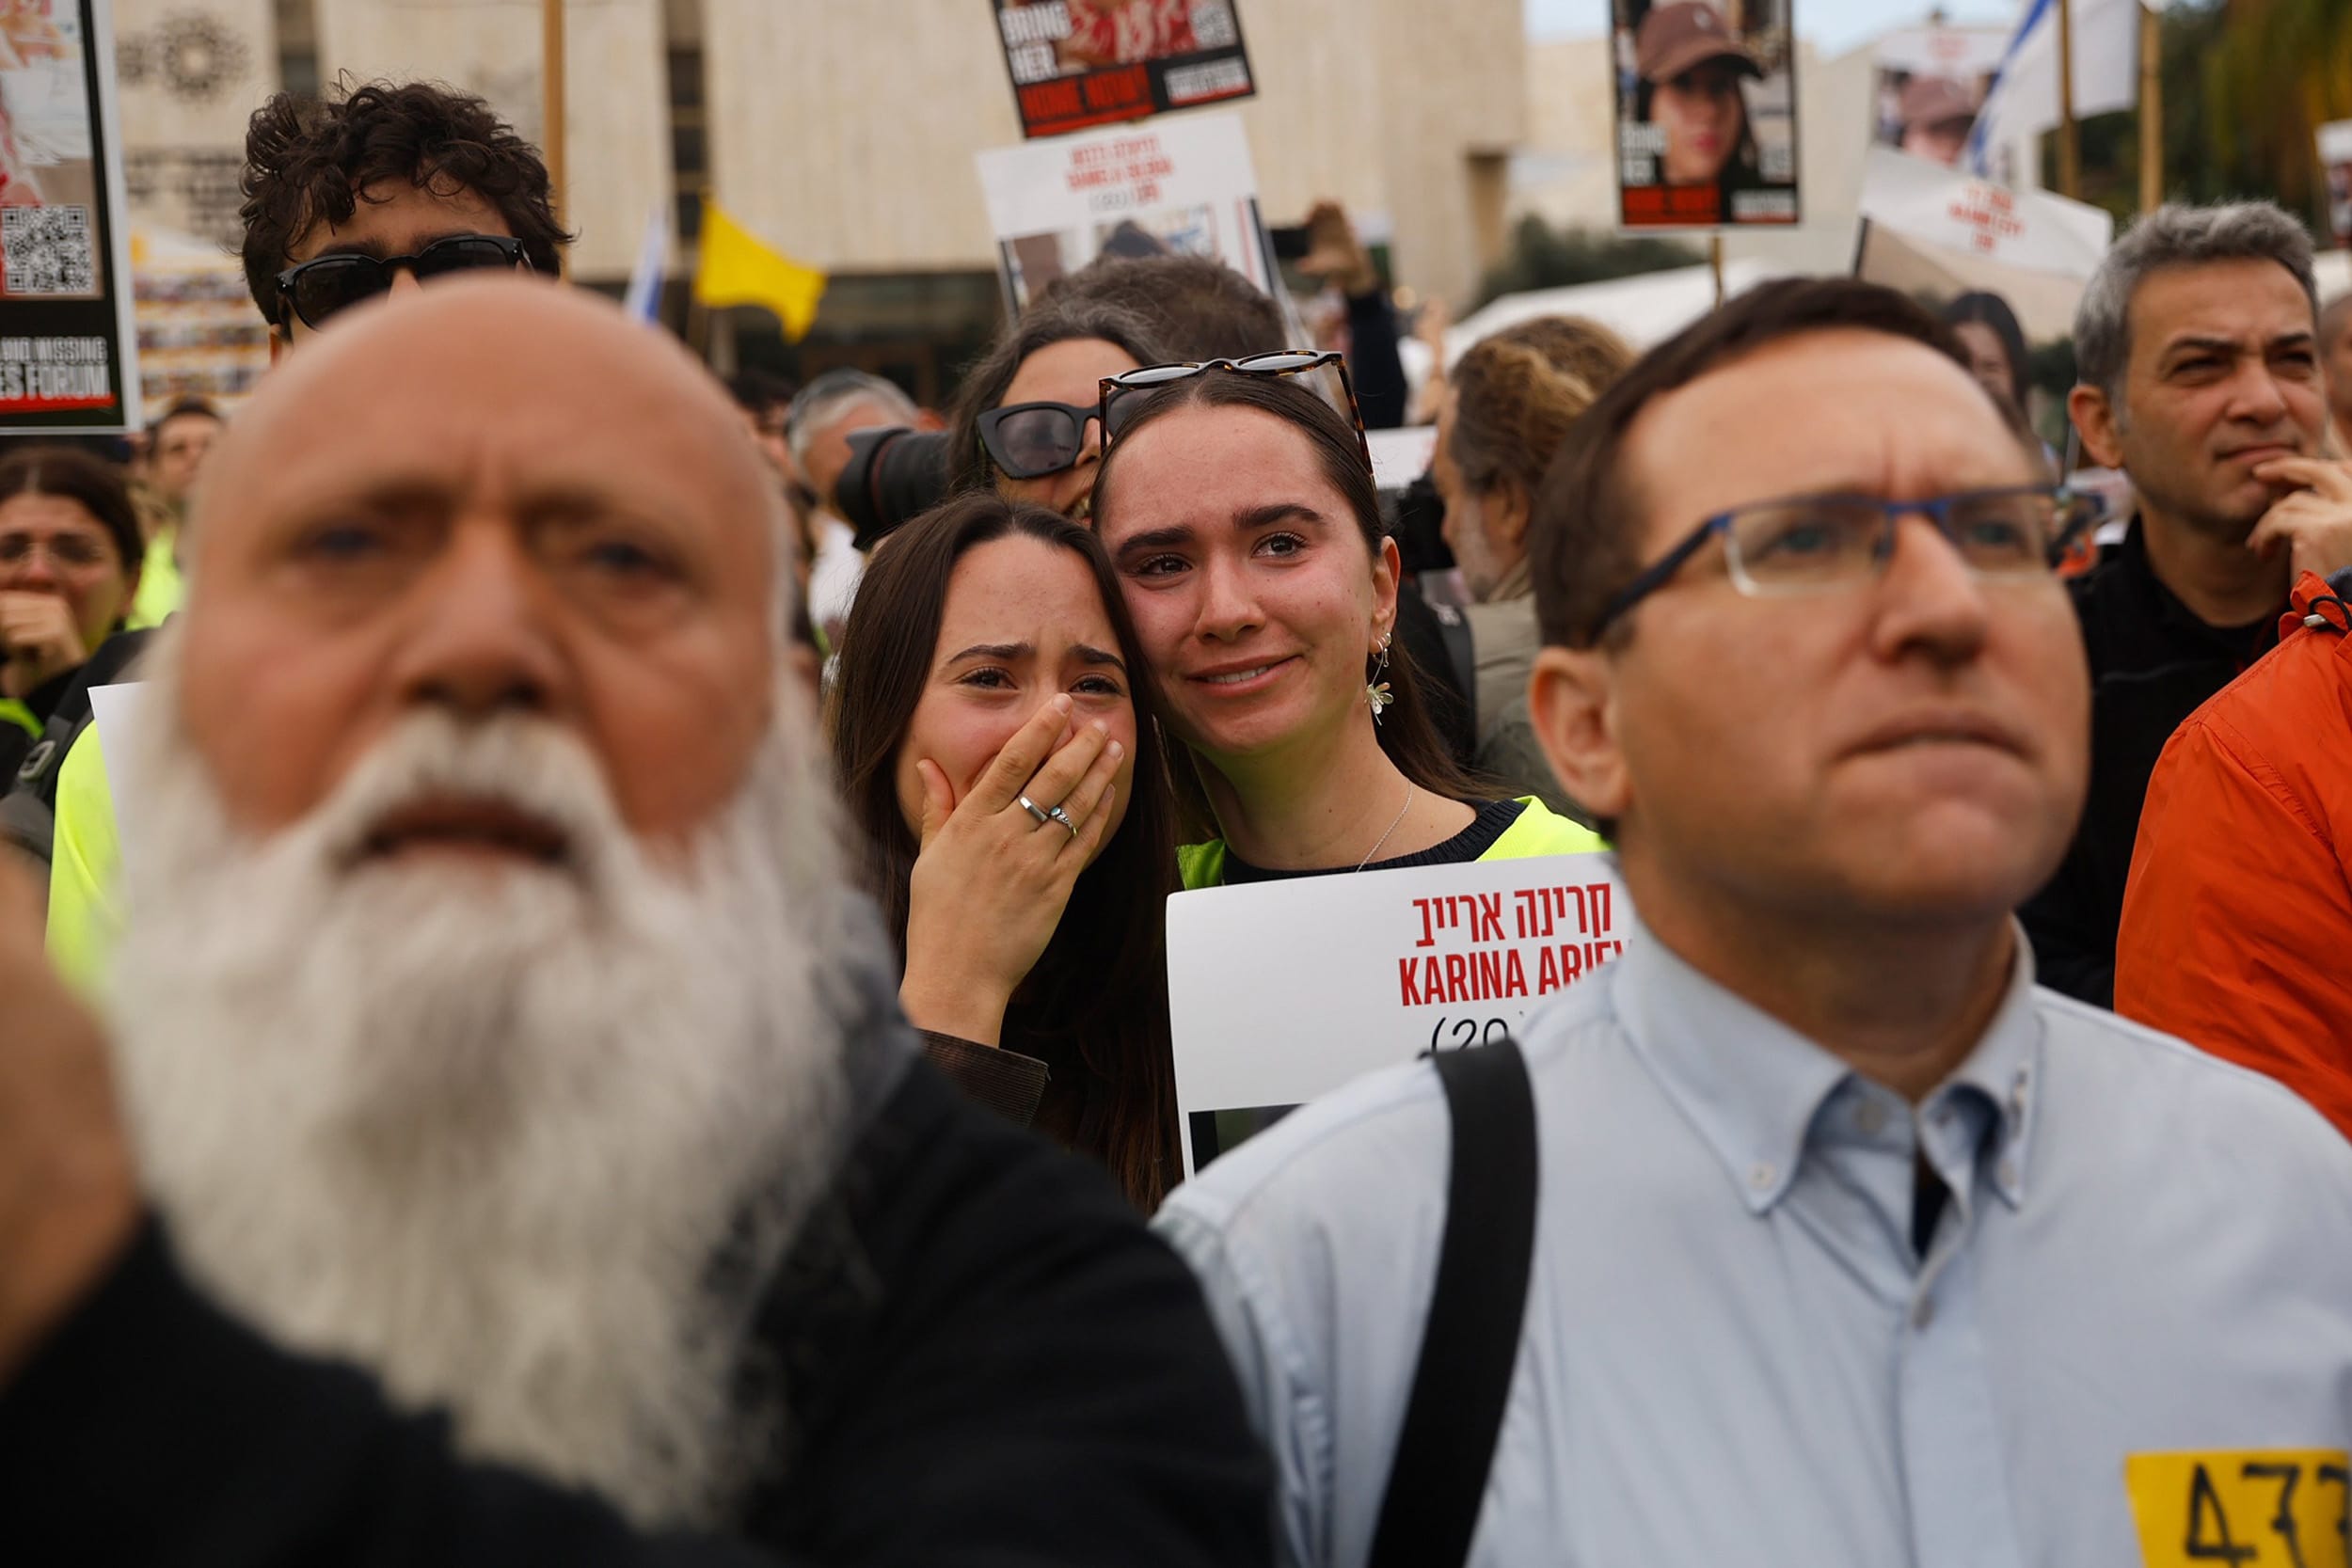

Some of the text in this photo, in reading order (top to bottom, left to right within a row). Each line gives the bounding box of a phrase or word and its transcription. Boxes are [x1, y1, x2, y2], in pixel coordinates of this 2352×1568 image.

[998, 4, 1071, 46] BRING
[36, 337, 108, 362] MISSING
[26, 362, 111, 401] FORUM
[1412, 882, 1612, 947] קרינה ארייב
[1398, 948, 1529, 1006] KARINA
[1538, 940, 1625, 996] ARI
